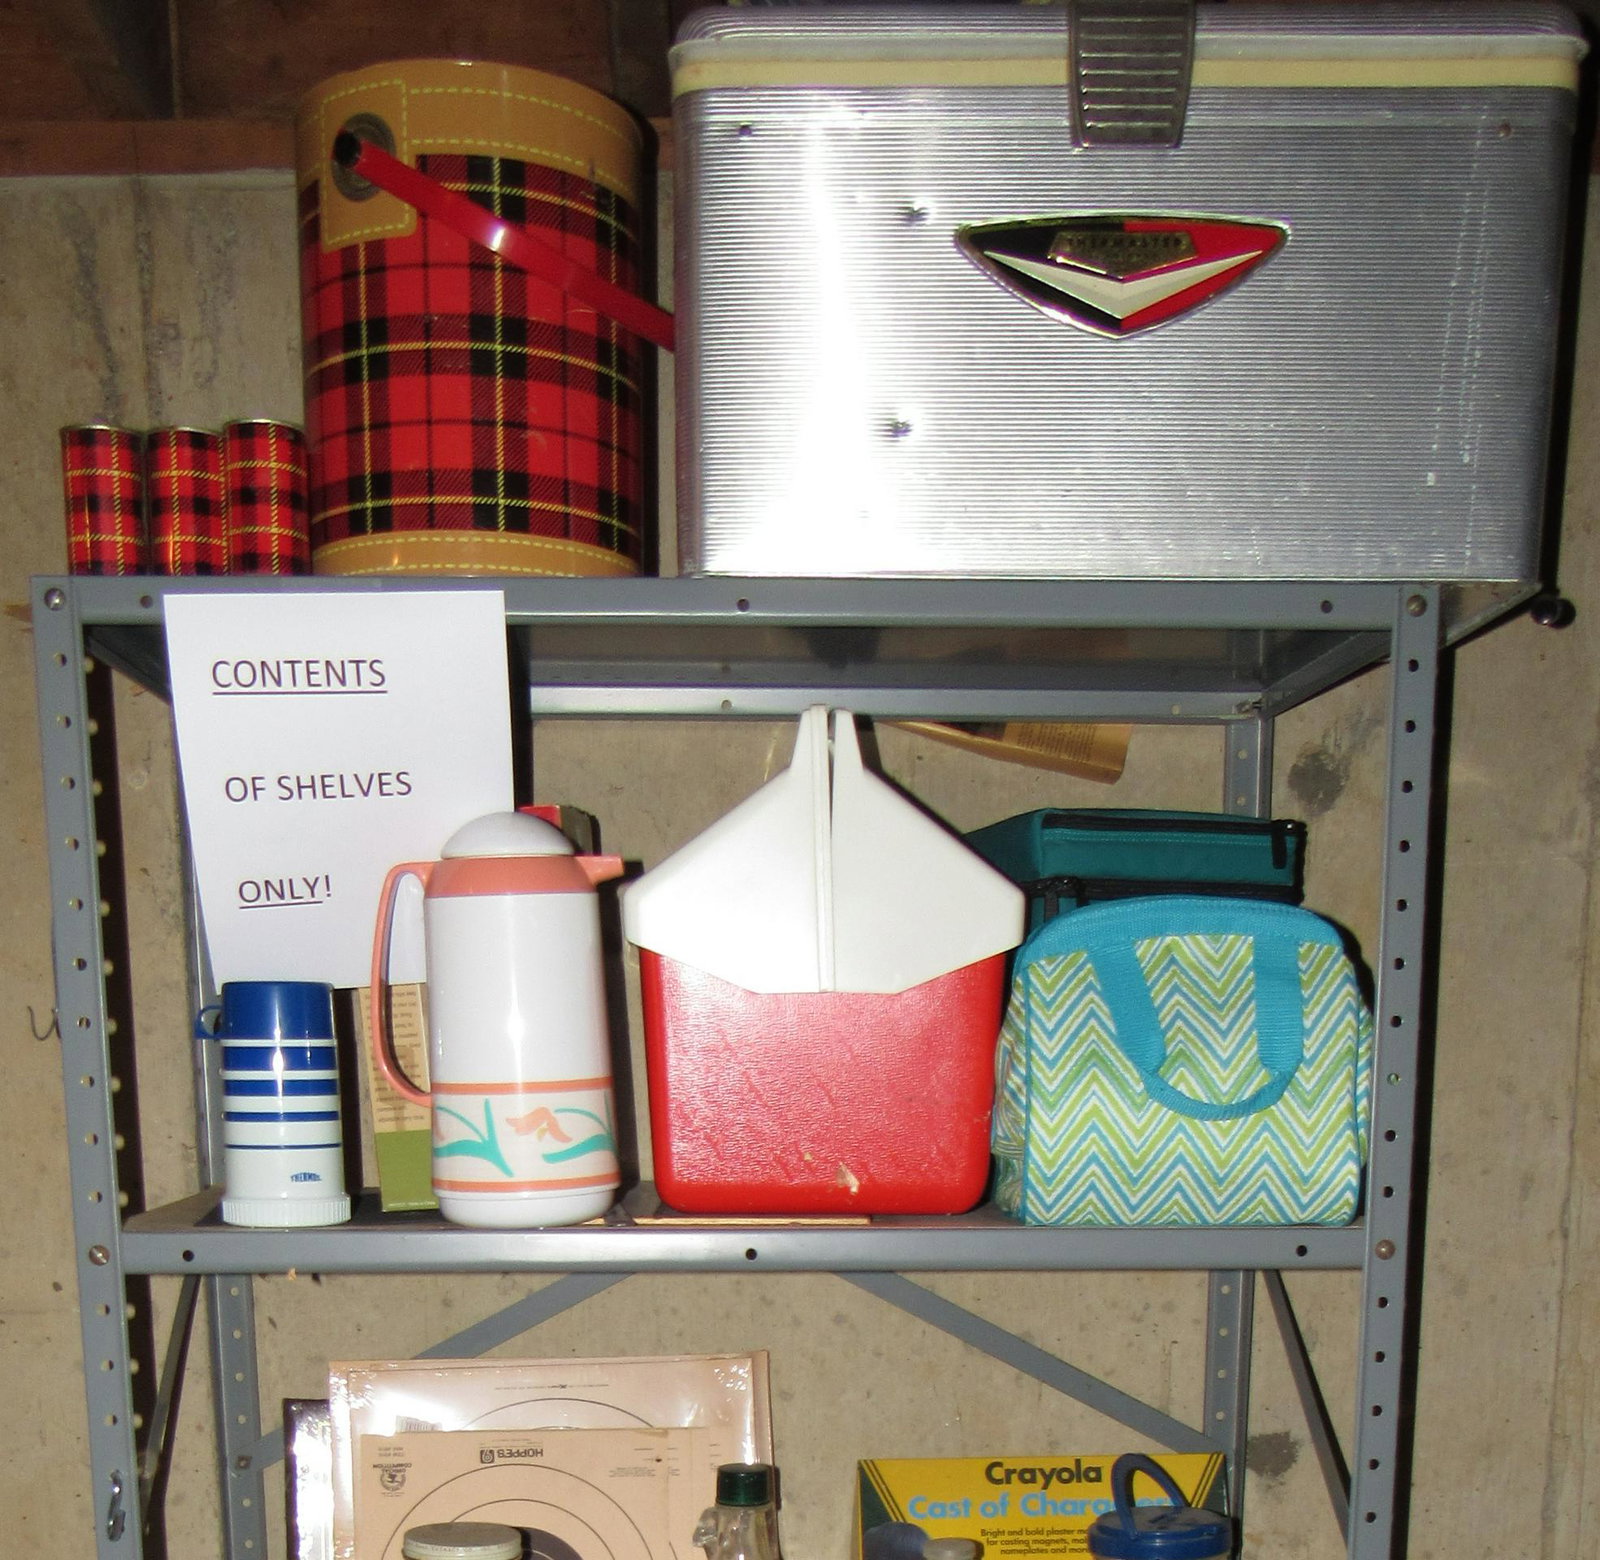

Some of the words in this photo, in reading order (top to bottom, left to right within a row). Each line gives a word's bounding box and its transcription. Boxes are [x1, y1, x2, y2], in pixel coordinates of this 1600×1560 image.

[212, 659, 387, 690] CONTENTS
[225, 776, 267, 803] OF
[277, 770, 412, 802] SHELVES
[239, 874, 332, 906] ONLY!
[984, 1459, 1103, 1489] Crayola
[908, 1496, 971, 1521] Cast
[979, 1492, 1011, 1518] of
[980, 1528, 1006, 1537] Bright
[1007, 1528, 1024, 1536] and
[1025, 1527, 1044, 1536] bold
[1046, 1528, 1075, 1537] plaster
[986, 1537, 998, 1546] for
[1000, 1538, 1030, 1548] casting
[1031, 1537, 1070, 1548] magnets,
[1000, 1547, 1049, 1556] nameplates
[1050, 1546, 1067, 1554] and
